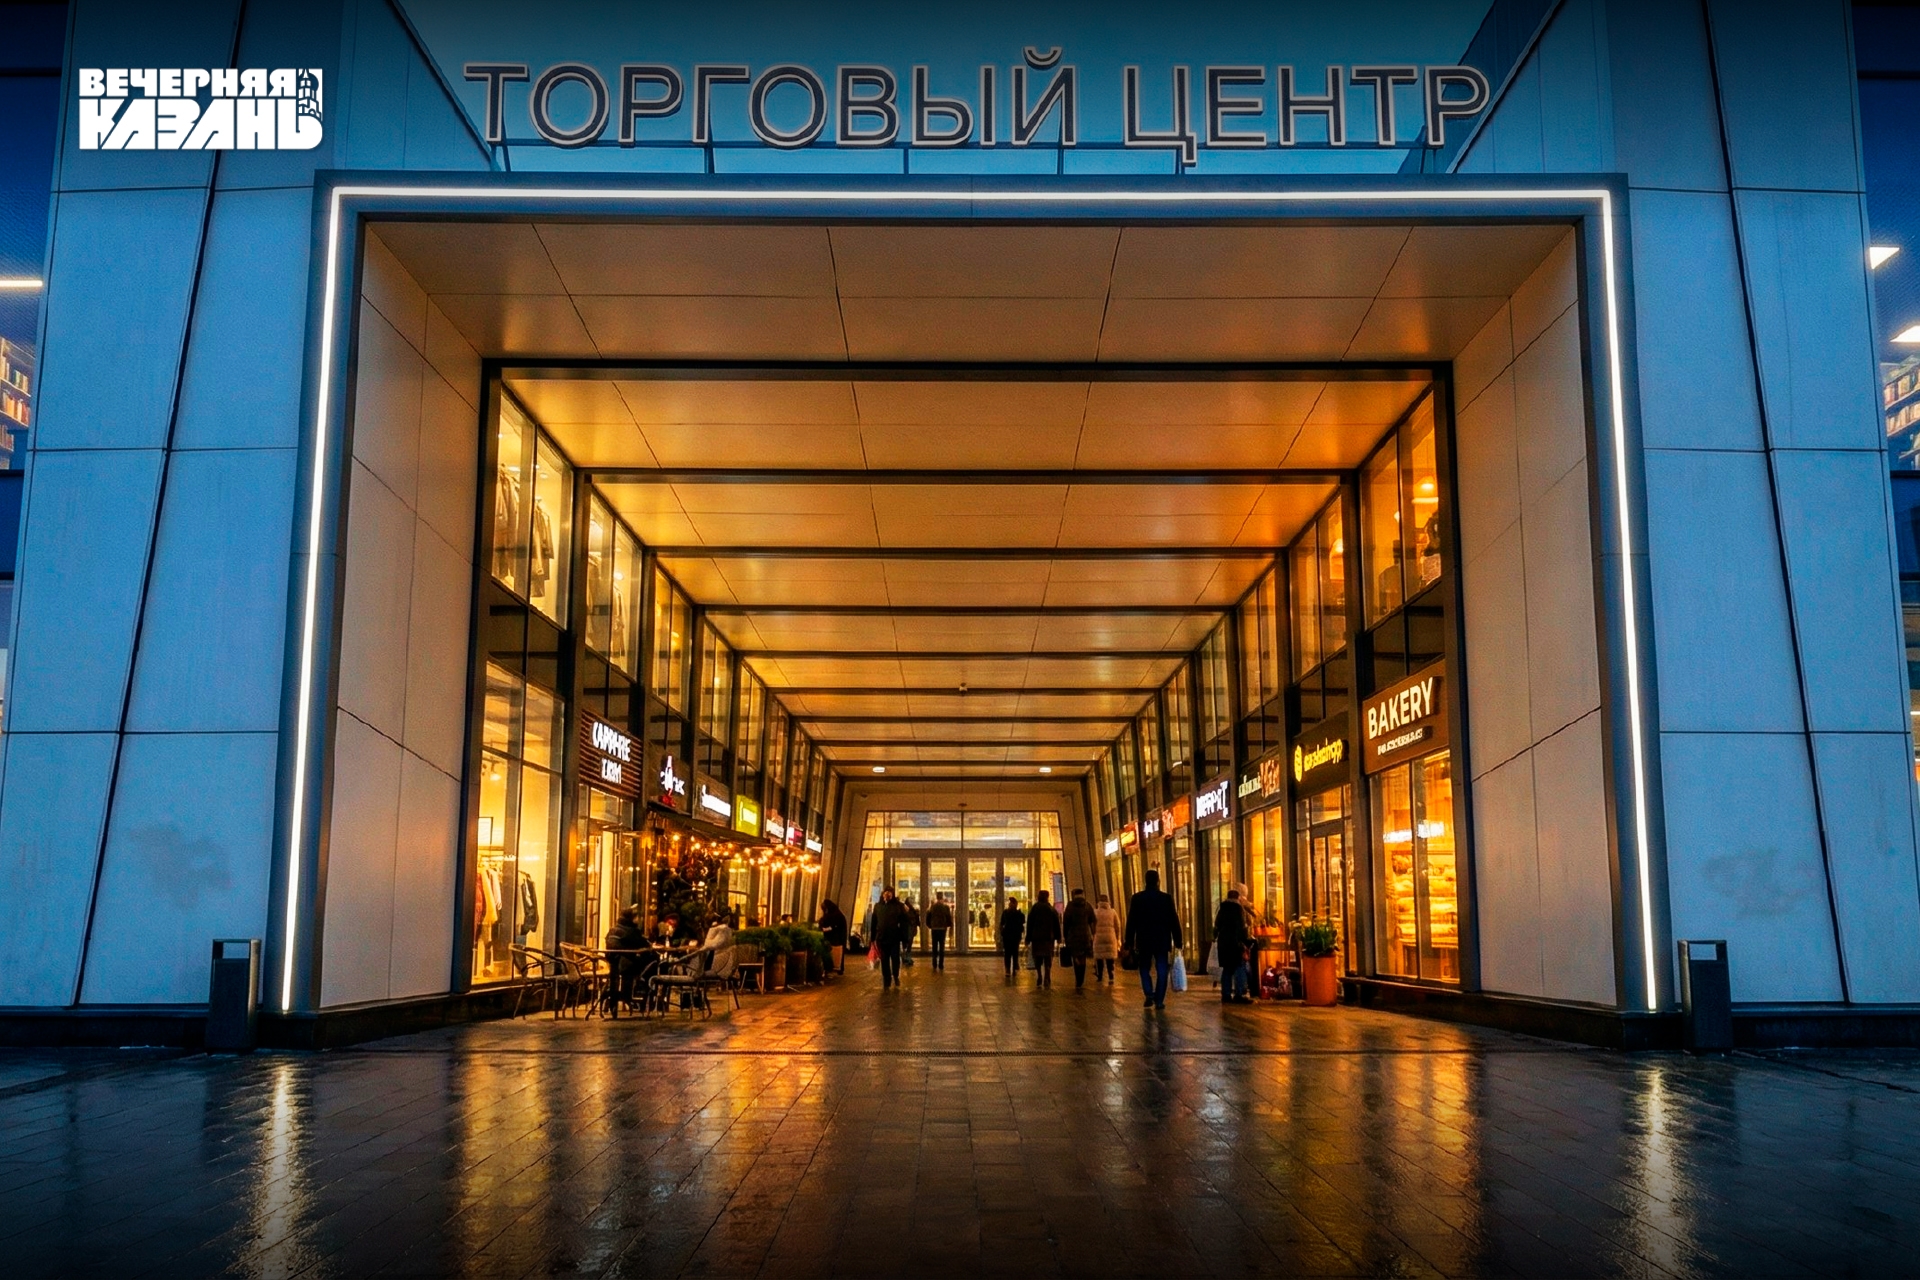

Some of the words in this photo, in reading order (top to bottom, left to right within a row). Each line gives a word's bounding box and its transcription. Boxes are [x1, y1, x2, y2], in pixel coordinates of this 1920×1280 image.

[463, 46, 1077, 148] ТОРГОВЫЙ
[1123, 65, 1490, 166] ЦЕНТР
[1368, 677, 1433, 740] BAKERY
